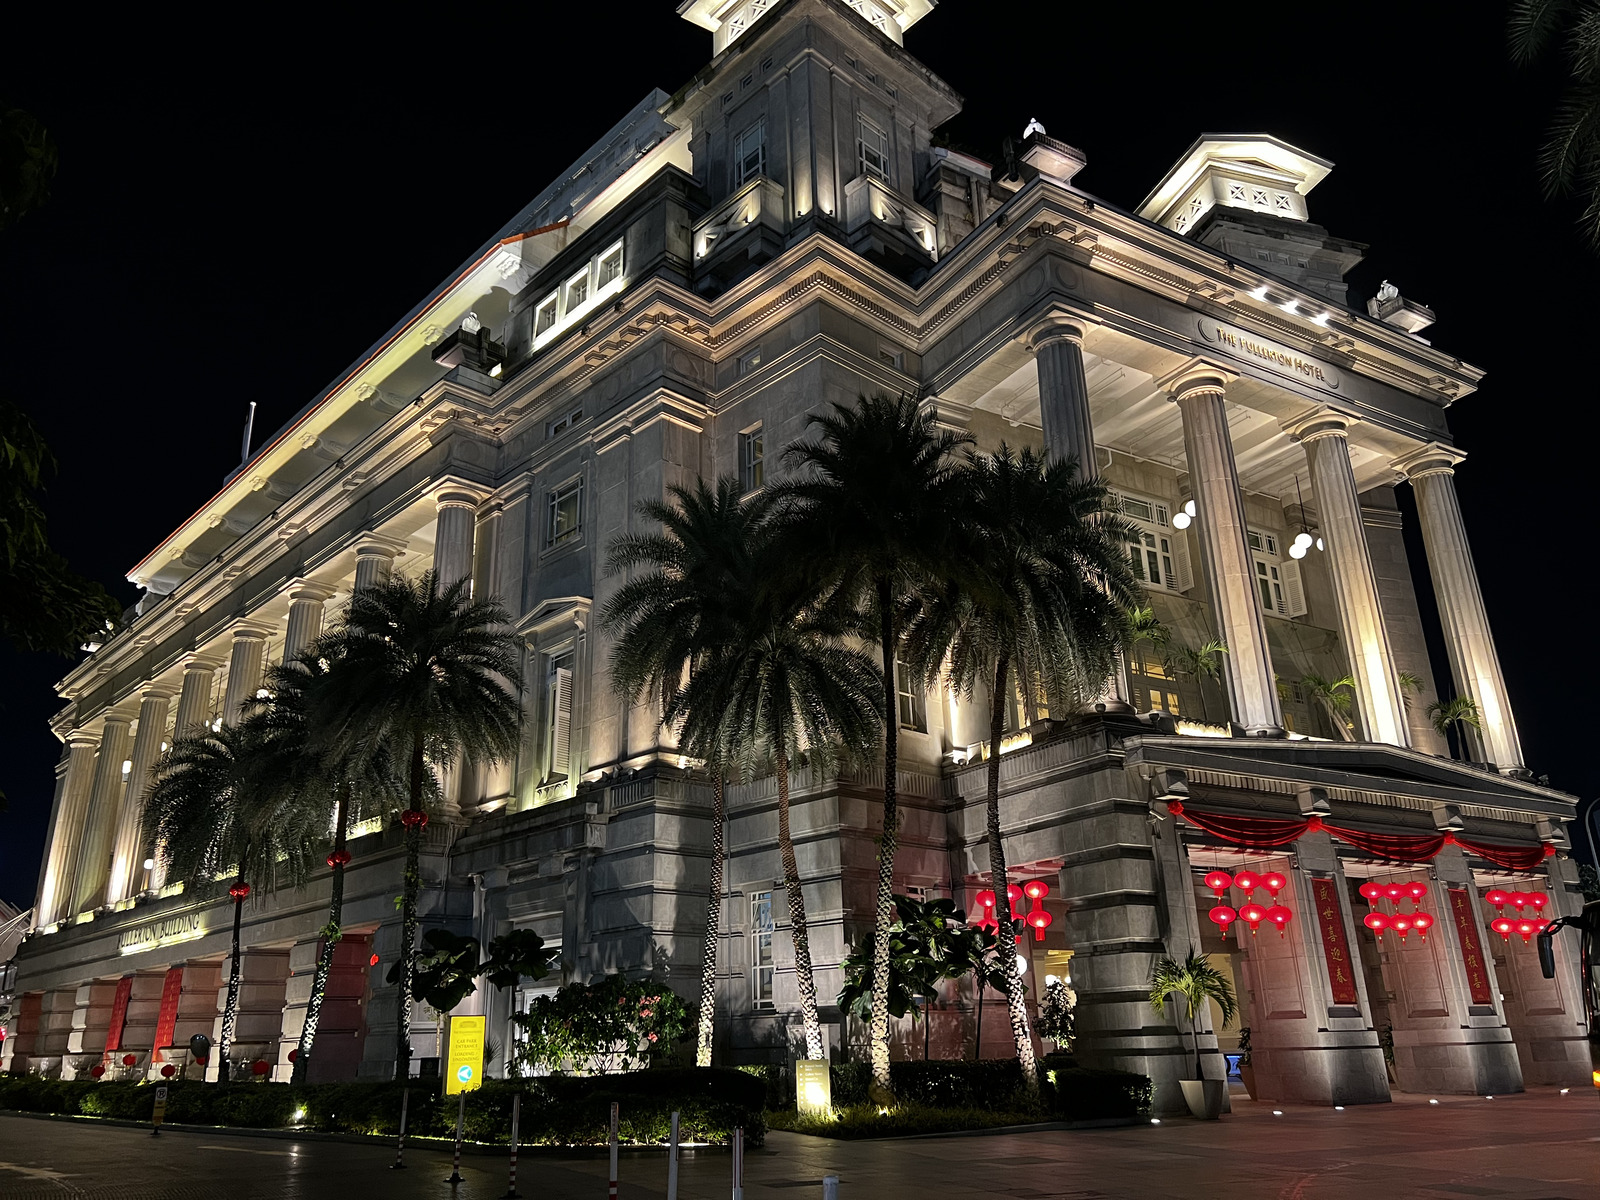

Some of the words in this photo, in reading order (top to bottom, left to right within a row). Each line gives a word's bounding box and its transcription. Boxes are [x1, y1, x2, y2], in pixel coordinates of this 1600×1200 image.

[1216, 327, 1237, 347] THE
[1240, 337, 1292, 367] FULLERTON
[1294, 357, 1325, 382] HOTEL
[160, 914, 199, 939] BUILDING
